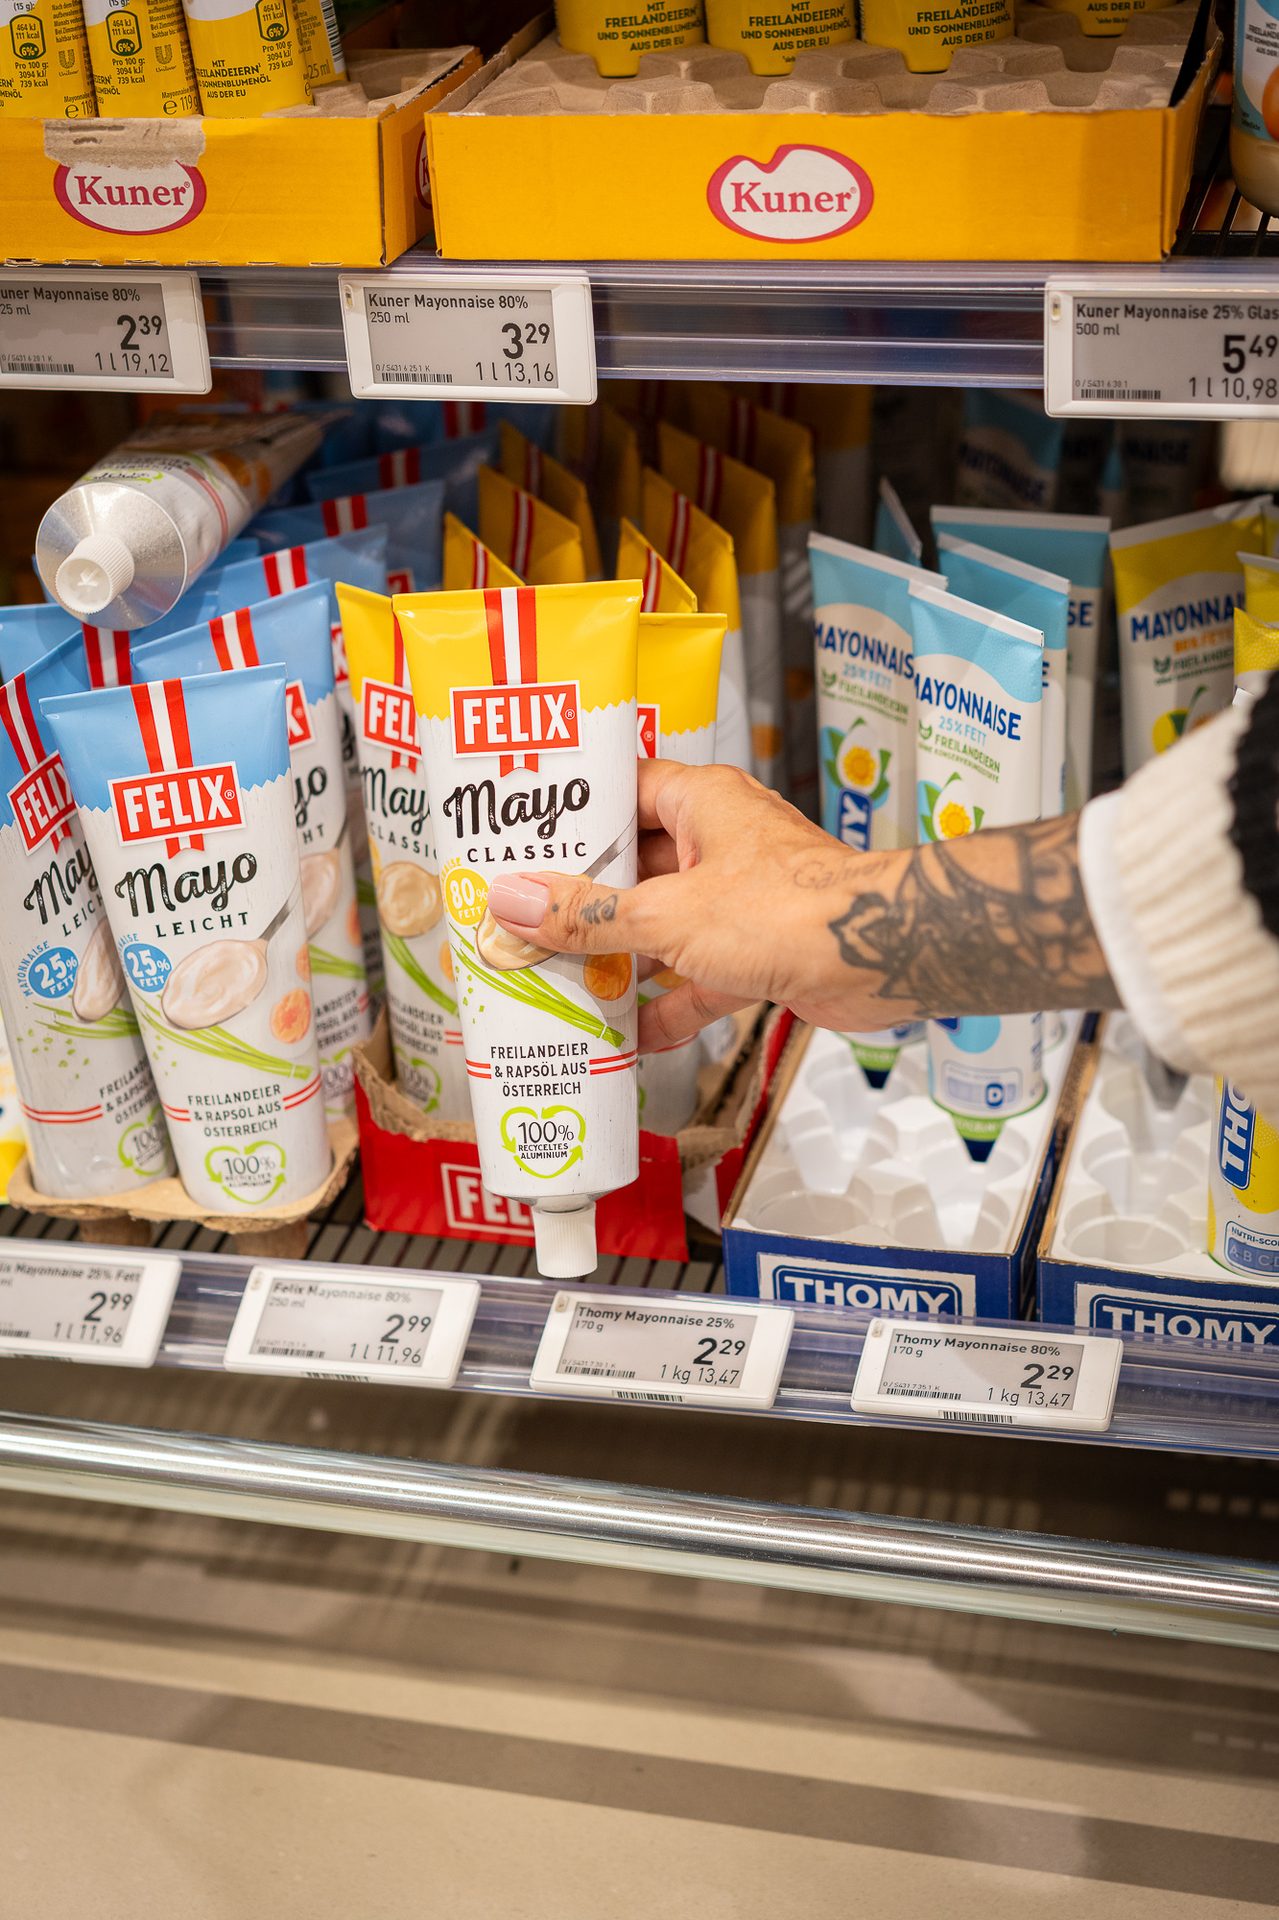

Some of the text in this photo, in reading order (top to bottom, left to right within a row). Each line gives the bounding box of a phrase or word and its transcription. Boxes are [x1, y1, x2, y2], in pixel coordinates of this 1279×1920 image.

[647, 2, 664, 11] MIT
[792, 2, 810, 11] MIT
[1087, 0, 1130, 11] AUS DER
[597, 32, 620, 40] UND
[741, 30, 762, 39] UND
[908, 26, 931, 35] UND
[942, 30, 995, 46] AUS DER EU
[630, 36, 684, 51] AUS DER EU
[773, 36, 830, 51] AUS DER EU
[112, 58, 123, 66] Pro
[116, 67, 132, 75] 3094
[131, 75, 145, 83] kcal
[236, 89, 246, 97] EU
[0, 287, 140, 303] uner Mayonnaise 80%
[368, 293, 529, 310] Kuner Mayonnaise 80%
[0, 303, 31, 316] 25 ml
[370, 311, 410, 323] 250 ml
[1076, 304, 1120, 318] Kuner
[1124, 304, 1209, 322] Mayonnaise
[1212, 305, 1244, 320] 25%
[1075, 323, 1120, 336] 500 ml
[95, 352, 103, 371] 1
[122, 353, 169, 374] 19,12
[475, 362, 483, 381] 1
[504, 362, 554, 384] 13,16
[1189, 377, 1196, 398] 1
[1222, 377, 1278, 401] 10,98
[814, 622, 914, 681] MAYONNAIS
[369, 690, 414, 746] FEL
[938, 715, 988, 748] 25% FETT
[934, 733, 1000, 773] FREILANDEIERN
[295, 766, 328, 828] yo
[361, 766, 431, 837] May
[443, 778, 590, 840] Mayo
[467, 841, 588, 864] CLASSIC
[24, 841, 100, 925] May
[114, 852, 258, 918] Mayo
[450, 878, 489, 910] 80%
[62, 893, 97, 937] LEIC
[459, 906, 483, 919] FETT
[155, 911, 249, 938] LEICHT
[17, 940, 50, 997] MAYONNAISE
[34, 952, 78, 990] 25%
[127, 950, 171, 978] 25%
[49, 974, 74, 995] FETT
[139, 975, 165, 987] FETT
[490, 1042, 589, 1060] FREILANDEIER
[494, 1061, 588, 1078] & RAPSÖL AUS
[188, 1083, 281, 1106] FREILANDEIER
[502, 1081, 582, 1097] ÖSTERREICH
[194, 1111, 203, 1121] &
[257, 1100, 281, 1116] AUS
[518, 1121, 574, 1144] 100%
[1221, 1078, 1252, 1172] THO
[518, 1143, 569, 1152] RECYCELTES
[520, 1151, 568, 1160] ALUMINIUM
[224, 1155, 276, 1175] 100%
[456, 1174, 531, 1226] FEL
[16, 1264, 140, 1282] Mayonnaise 25% Fett
[273, 1282, 412, 1303] Felix Mayonnaise 80%
[291, 1298, 306, 1308] ml
[784, 1276, 950, 1314] THOMY
[575, 1320, 604, 1333] 170 g
[578, 1306, 736, 1329] Thomy Mayonnaise 25%
[1103, 1305, 1277, 1345] THOMY
[54, 1322, 61, 1339] 1
[80, 1324, 122, 1344] 11,96
[350, 1343, 357, 1359] 1
[378, 1345, 422, 1365] 11,96
[893, 1346, 923, 1358] 170 g
[895, 1333, 1061, 1357] Thomy Mayonnaise 80%
[660, 1364, 740, 1385] 1 kg 13,47
[987, 1387, 1071, 1408] 1 kg 13,47
